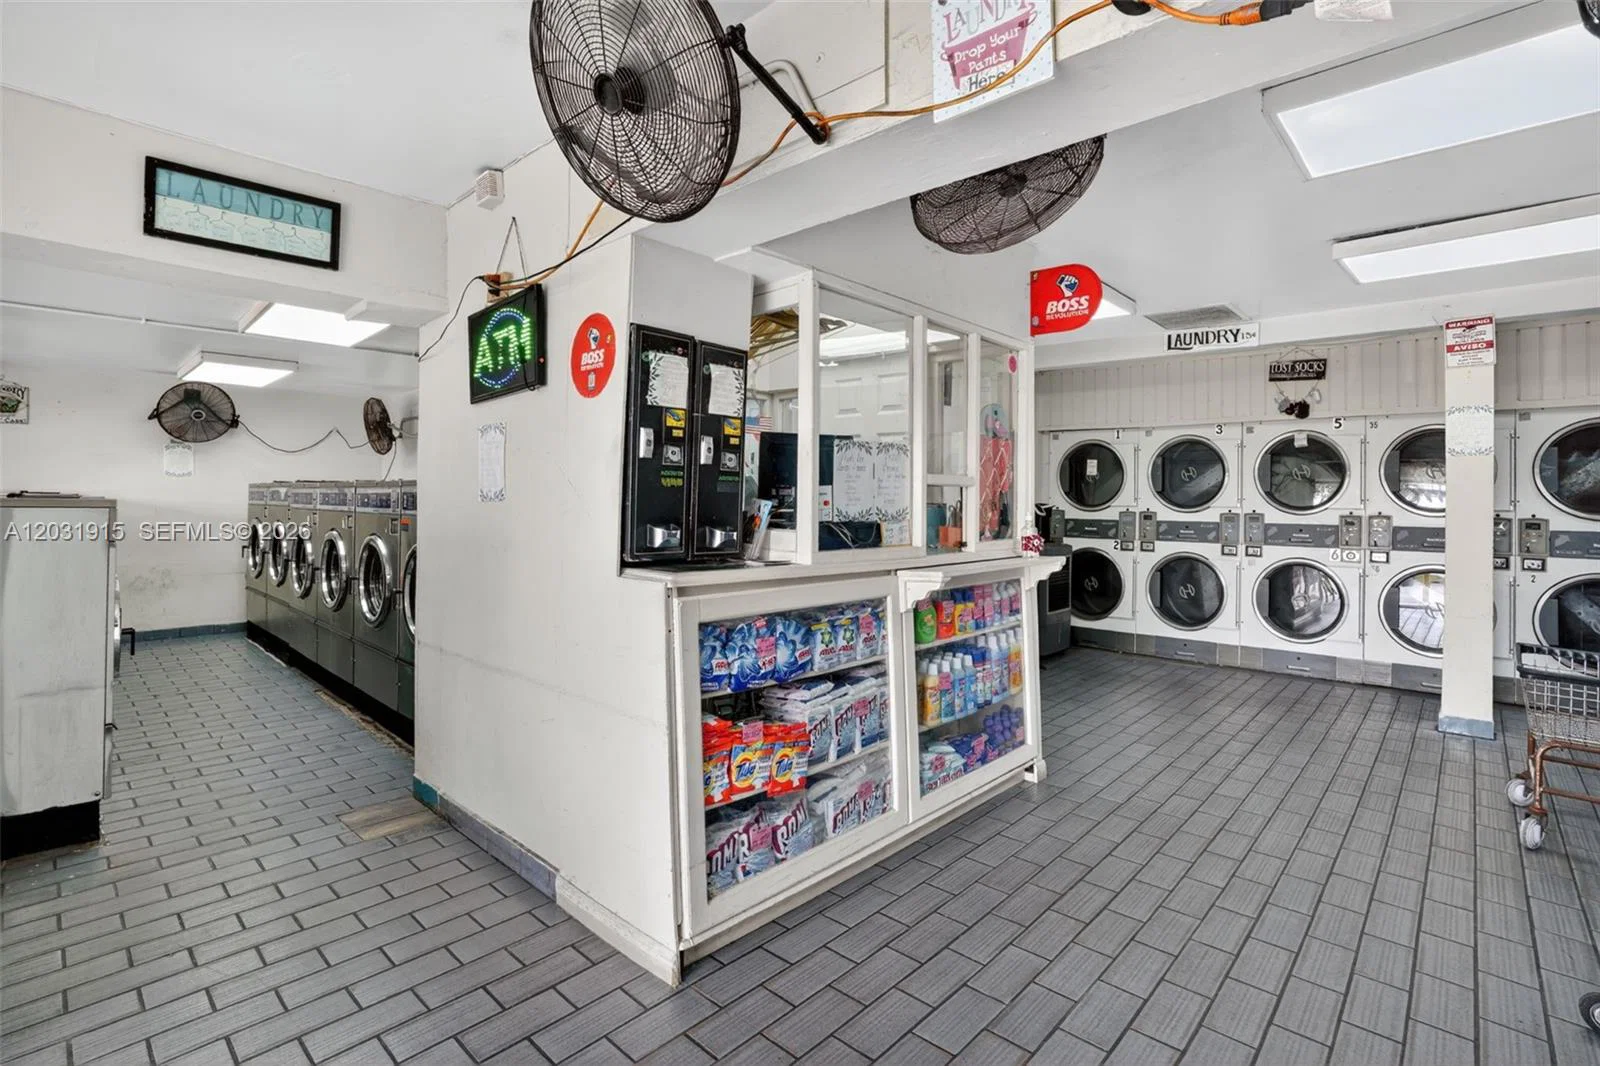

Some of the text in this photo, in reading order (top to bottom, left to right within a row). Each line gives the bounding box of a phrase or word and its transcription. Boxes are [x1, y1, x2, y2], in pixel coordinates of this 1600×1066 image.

[953, 27, 1020, 64] Drop Your
[968, 50, 1007, 73] Pants
[166, 171, 325, 230] LAUNDRY
[1045, 295, 1090, 315] BOSS
[1167, 329, 1241, 350] LAUNDRY
[474, 318, 531, 377] ATM
[1453, 342, 1487, 352] AVISO
[581, 349, 605, 366] BOSS
[1271, 360, 1325, 373] LOST SOCKS
[1215, 424, 1223, 434] 3
[1334, 418, 1342, 429] 5
[1116, 430, 1121, 439] 1
[1113, 540, 1119, 550] 2
[1330, 550, 1339, 560] 6
[1530, 574, 1536, 583] 2
